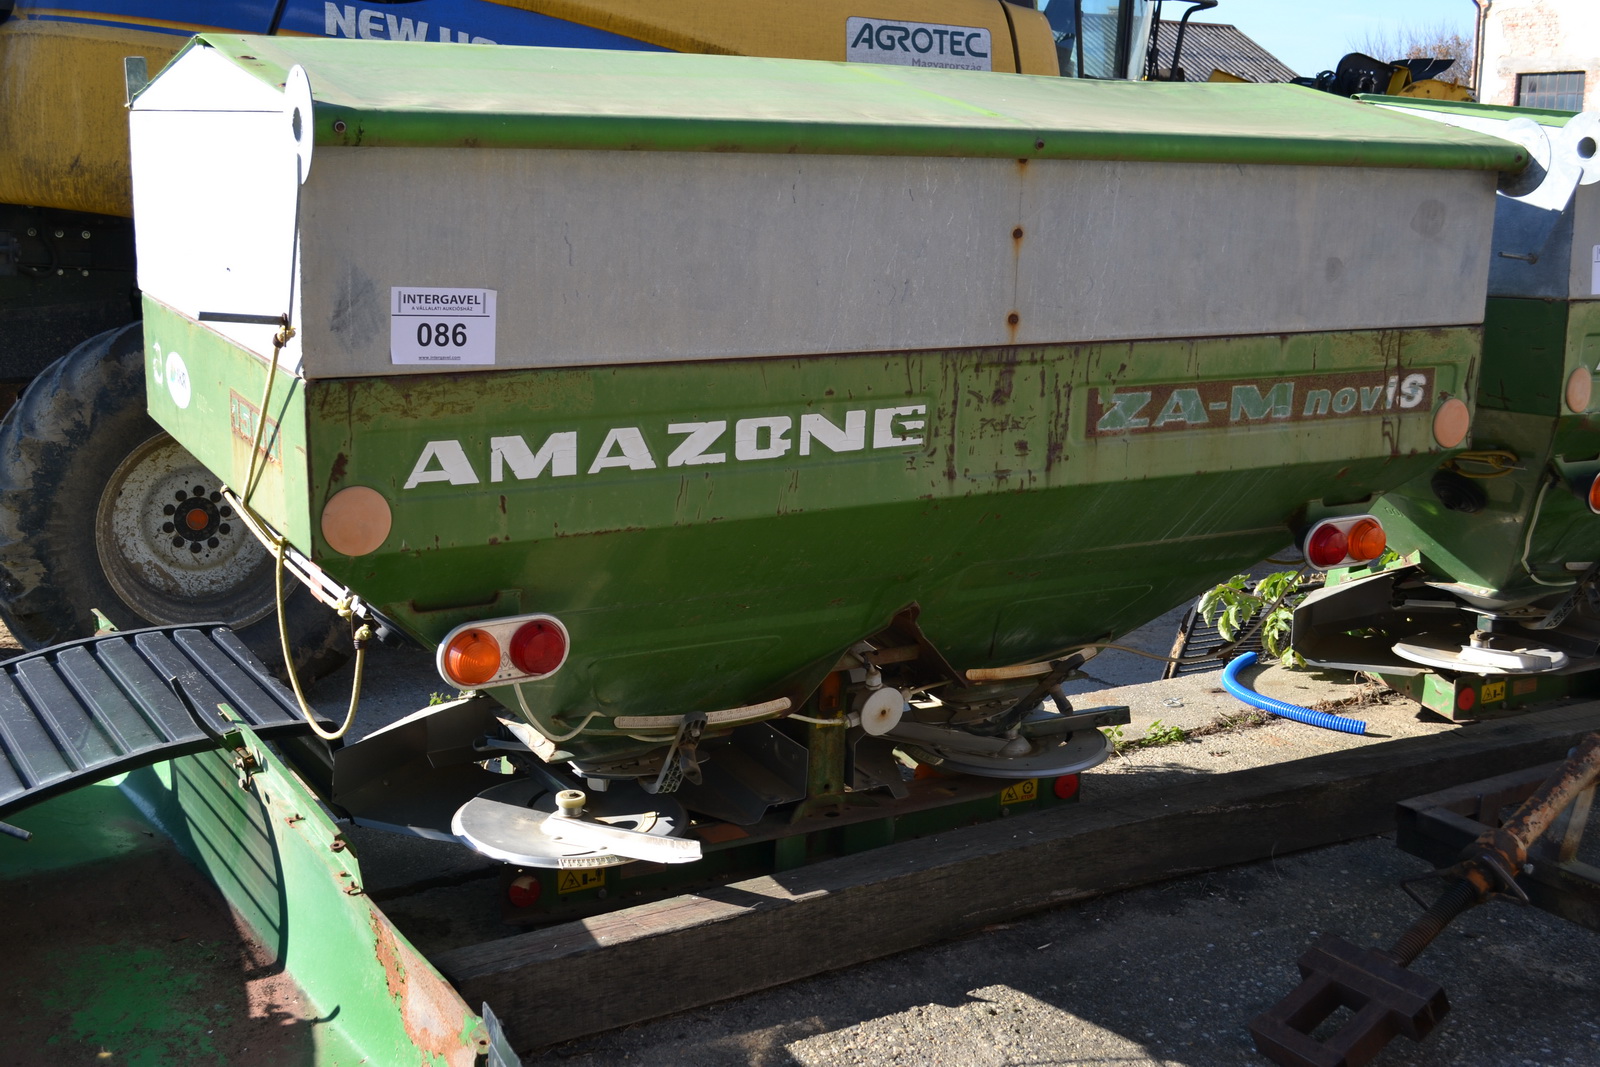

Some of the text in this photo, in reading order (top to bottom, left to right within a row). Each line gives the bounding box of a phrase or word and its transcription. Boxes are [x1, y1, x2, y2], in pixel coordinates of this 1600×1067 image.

[324, 1, 429, 42] NEW
[851, 23, 988, 58] AGROTEC
[403, 294, 481, 304] INTERGAVEL
[417, 322, 467, 347] 086
[1096, 382, 1294, 431] ZA-M
[403, 404, 927, 490] AMAZONE
